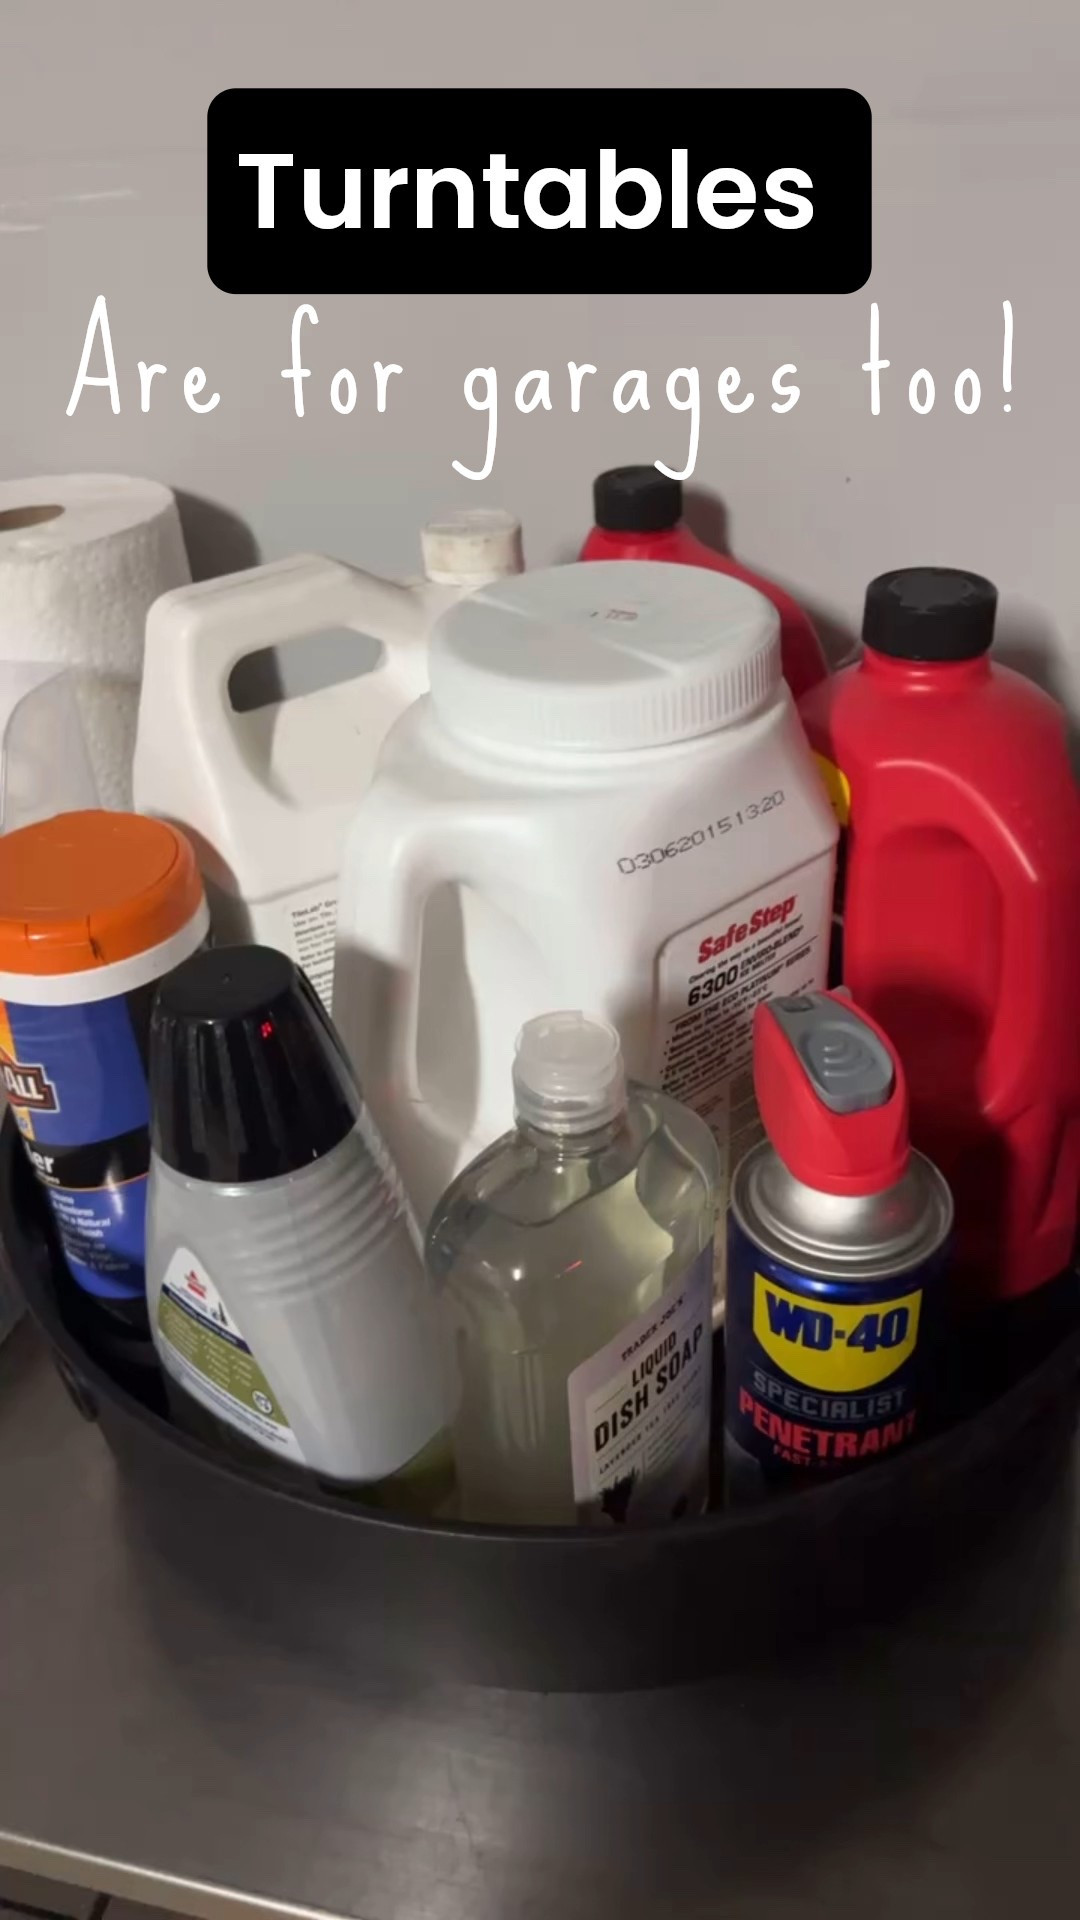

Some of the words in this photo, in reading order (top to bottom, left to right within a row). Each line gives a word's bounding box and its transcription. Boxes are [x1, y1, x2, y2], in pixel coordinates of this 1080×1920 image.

[688, 964, 738, 1006] 6300
[675, 1011, 702, 1032] FROM
[704, 1002, 720, 1017] THE
[4, 1065, 44, 1101] ALL
[765, 1289, 910, 1353] WD-40
[631, 1330, 678, 1388] LIQUID
[594, 1381, 650, 1452] DISH
[656, 1322, 704, 1395] SOAP
[753, 1370, 907, 1420] SPECIALIST
[739, 1385, 917, 1458] PENETRANT
